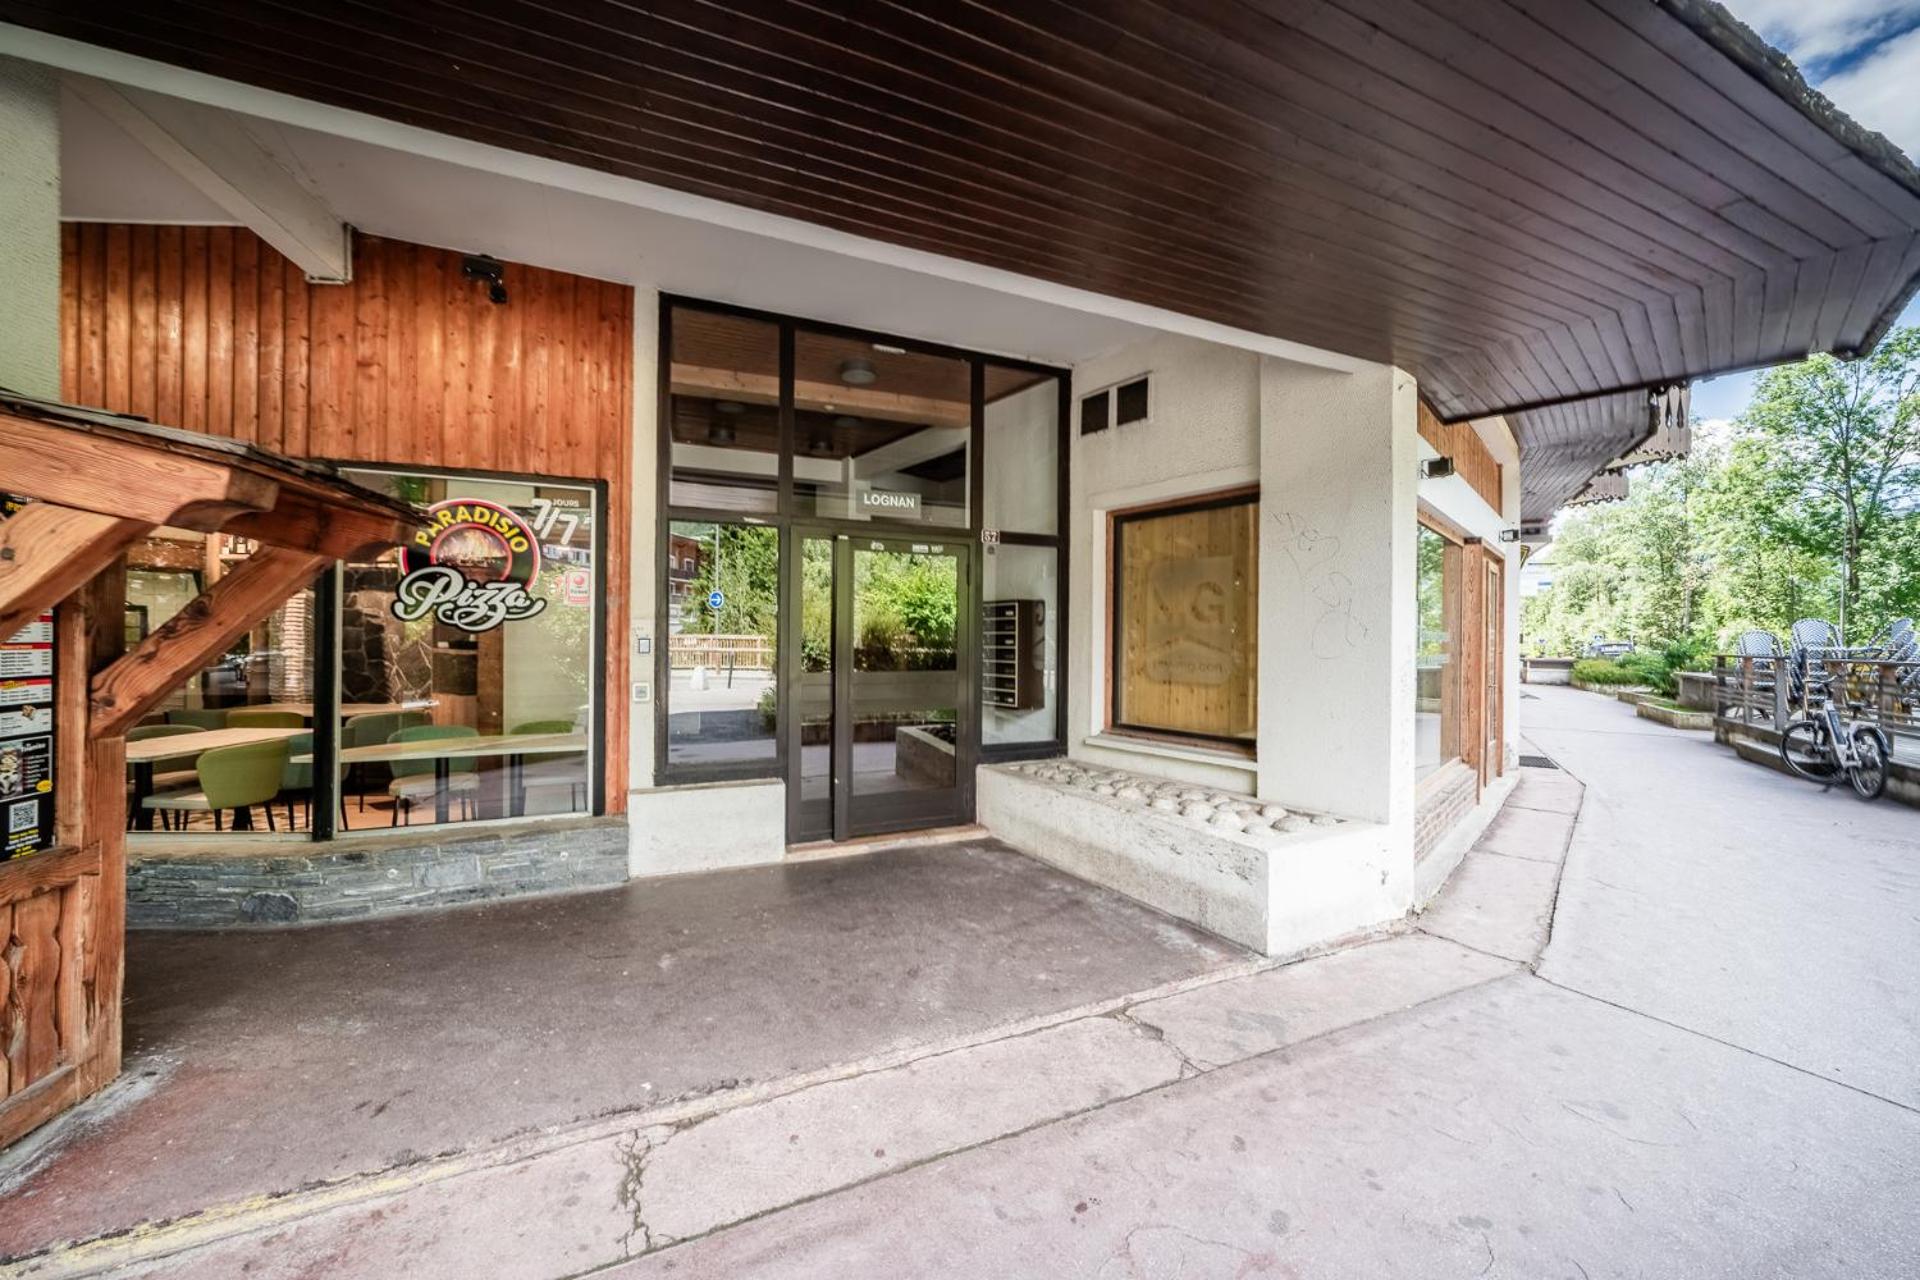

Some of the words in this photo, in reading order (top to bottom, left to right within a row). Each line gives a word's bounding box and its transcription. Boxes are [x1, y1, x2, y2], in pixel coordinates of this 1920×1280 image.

[531, 498, 578, 546] 7/7
[863, 493, 915, 508] LOGNAN
[415, 505, 529, 553] PARADISIO
[393, 566, 547, 632] Pizza
